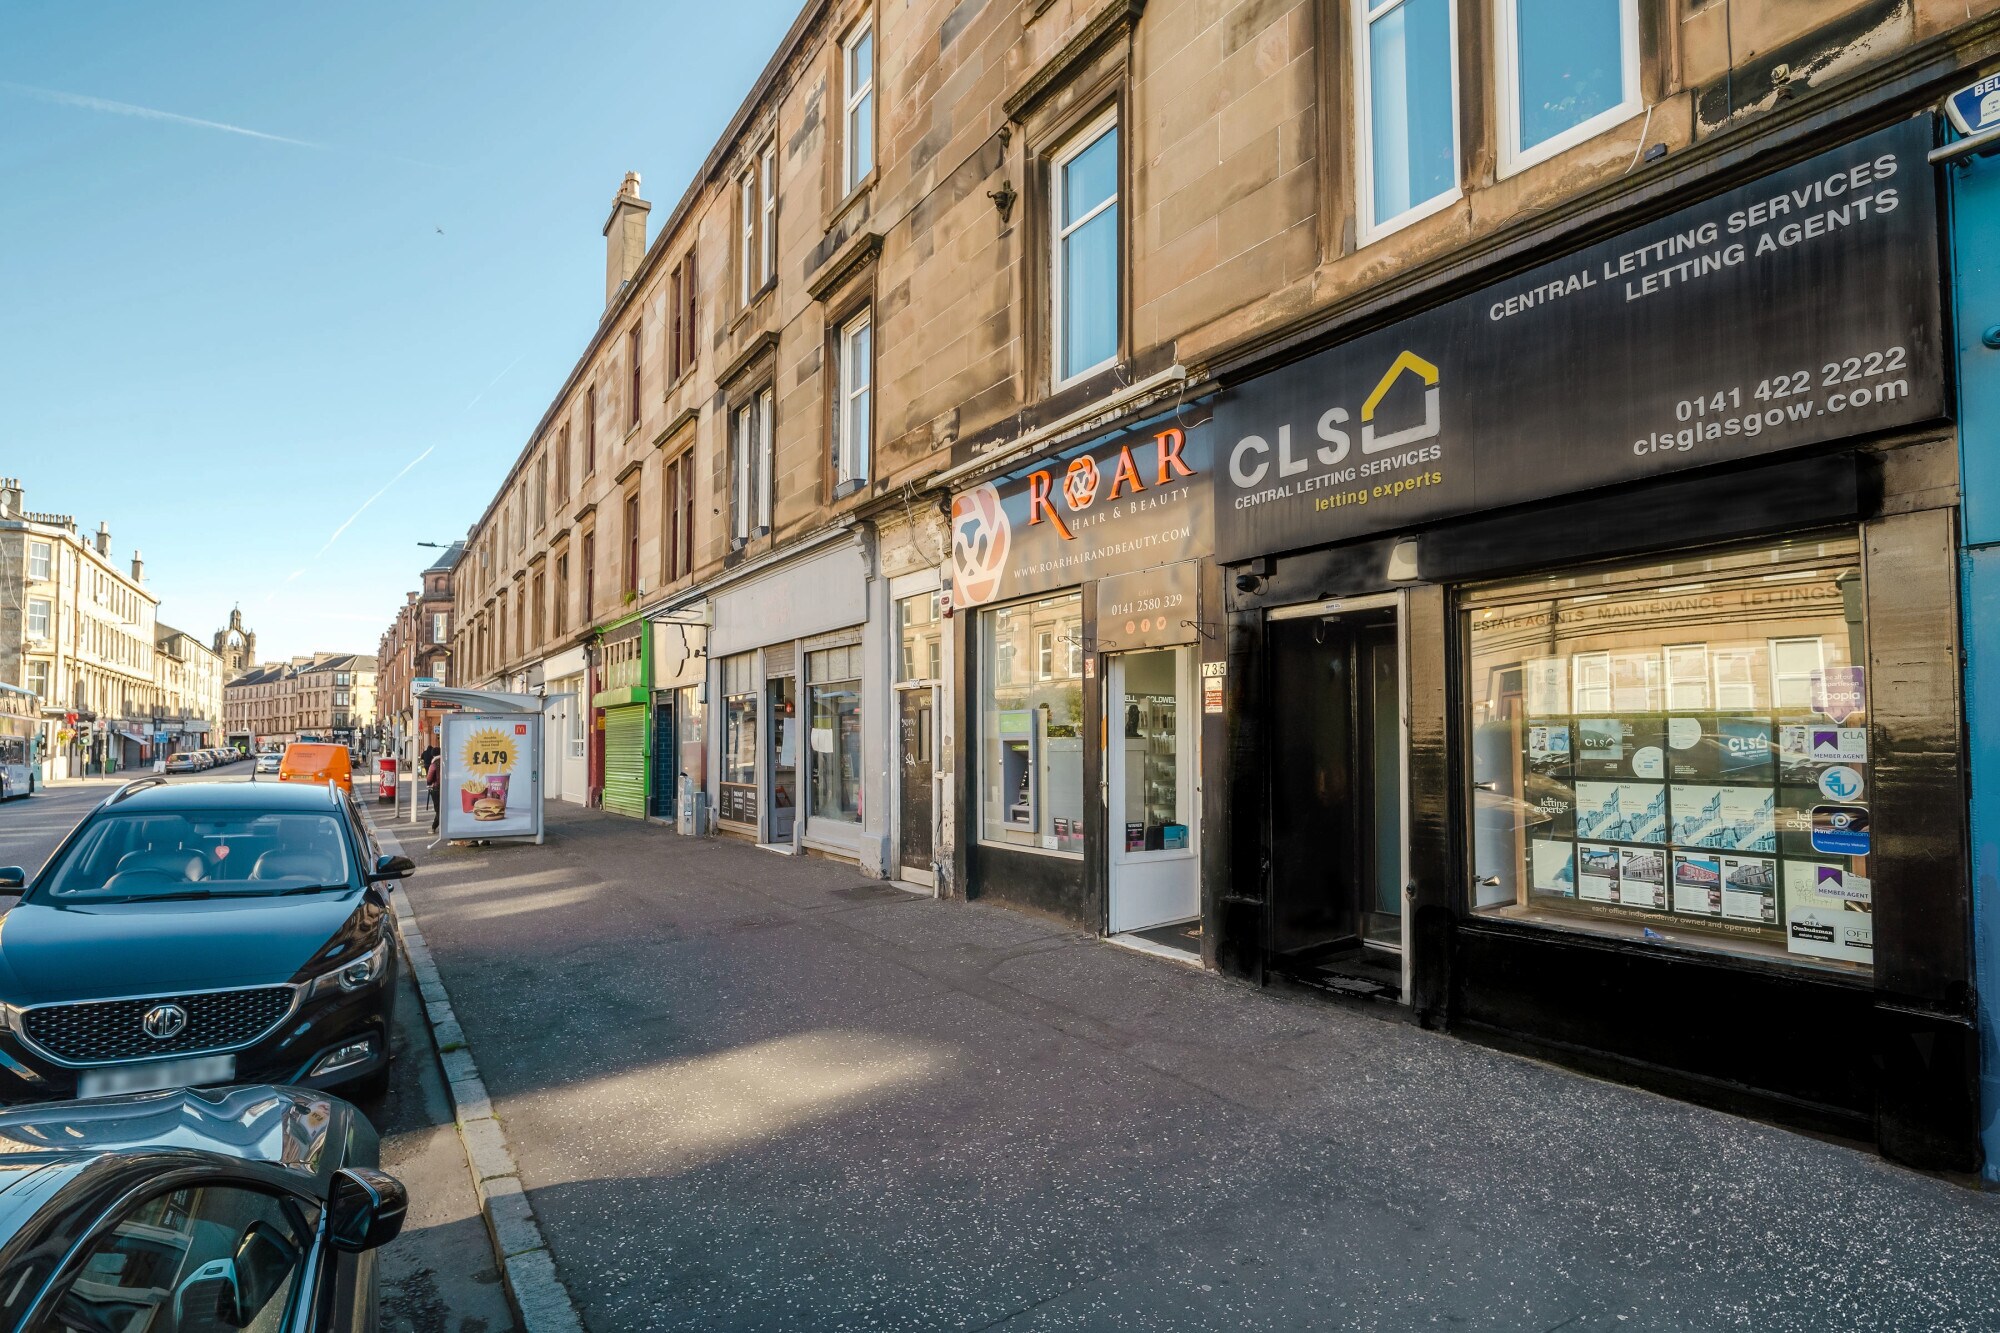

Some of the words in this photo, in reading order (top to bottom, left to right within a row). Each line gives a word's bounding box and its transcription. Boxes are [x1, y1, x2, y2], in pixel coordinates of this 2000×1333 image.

[1489, 269, 1598, 321] CENTRAL
[1603, 221, 1719, 281] LETTING
[1726, 152, 1899, 235] SERVICES
[1625, 243, 1746, 302] LETTING
[1754, 187, 1900, 257] AGENTS
[1675, 386, 1742, 422] 0141
[1753, 370, 1811, 401] 422
[1821, 345, 1907, 387] 2222
[1632, 378, 1909, 456] clsglasgow.com
[1228, 406, 1351, 488] CLS
[1234, 486, 1294, 510] CENTRAL
[1296, 467, 1357, 495] LETTING
[1359, 443, 1442, 478] SERVICES
[1314, 488, 1369, 512] letting
[1372, 470, 1443, 499] experts
[1071, 512, 1106, 532] HAIR
[1112, 506, 1122, 519] &
[1130, 486, 1190, 514] BEAUTY
[1013, 525, 1191, 579] WWW.ROARHAIRANDBEAUTY.COM
[1111, 601, 1133, 616] 0141
[1137, 597, 1161, 612] 2580
[1163, 593, 1183, 608] 329
[1472, 616, 1523, 632] ESTATE
[1525, 610, 1586, 628] AGENTS
[1597, 595, 1724, 620] MAINTENANCE
[1739, 585, 1842, 606] LETTINGS
[1204, 662, 1225, 676] 735
[1817, 690, 1860, 701] Zoopla
[1584, 738, 1605, 748] CLS
[1728, 737, 1756, 752] CLS
[1842, 731, 1865, 740] CLA
[472, 750, 508, 765] £4.79
[1533, 805, 1564, 815] experts
[1540, 797, 1569, 809] letting
[1818, 888, 1846, 896] MEMBER
[1591, 905, 1607, 913] each
[1608, 906, 1628, 916] office
[1680, 917, 1706, 927] owned
[1707, 920, 1722, 929] and
[1724, 923, 1761, 934] operated
[1846, 929, 1869, 939] OFT
[148, 1008, 185, 1036] MG
